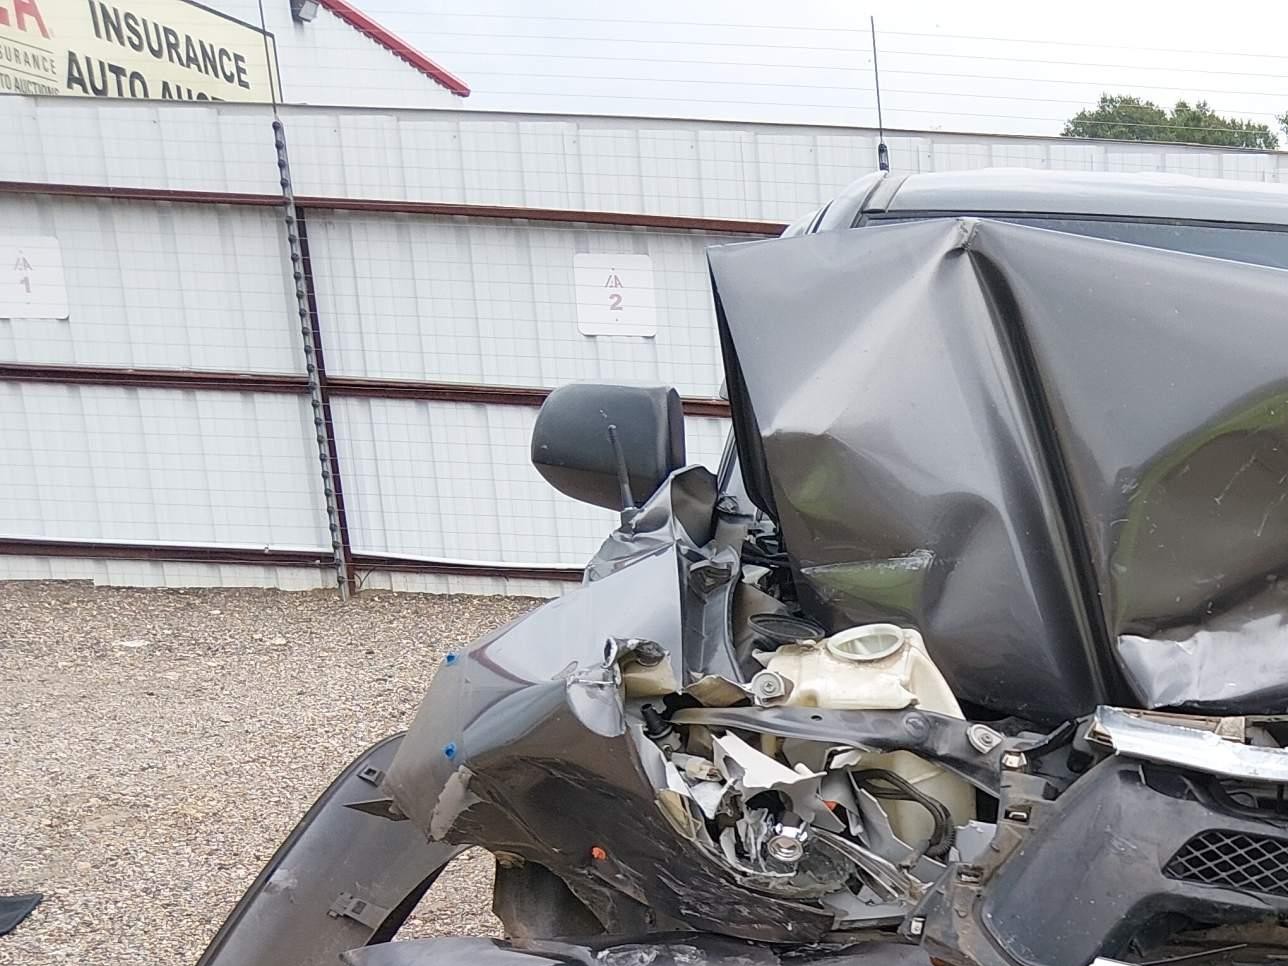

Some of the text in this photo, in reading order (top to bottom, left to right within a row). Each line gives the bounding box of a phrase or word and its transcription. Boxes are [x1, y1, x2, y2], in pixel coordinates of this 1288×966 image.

[88, 0, 250, 90] INSURANCE
[67, 50, 149, 99] AUTO
[20, 276, 31, 293] 1
[609, 293, 623, 310] 2
